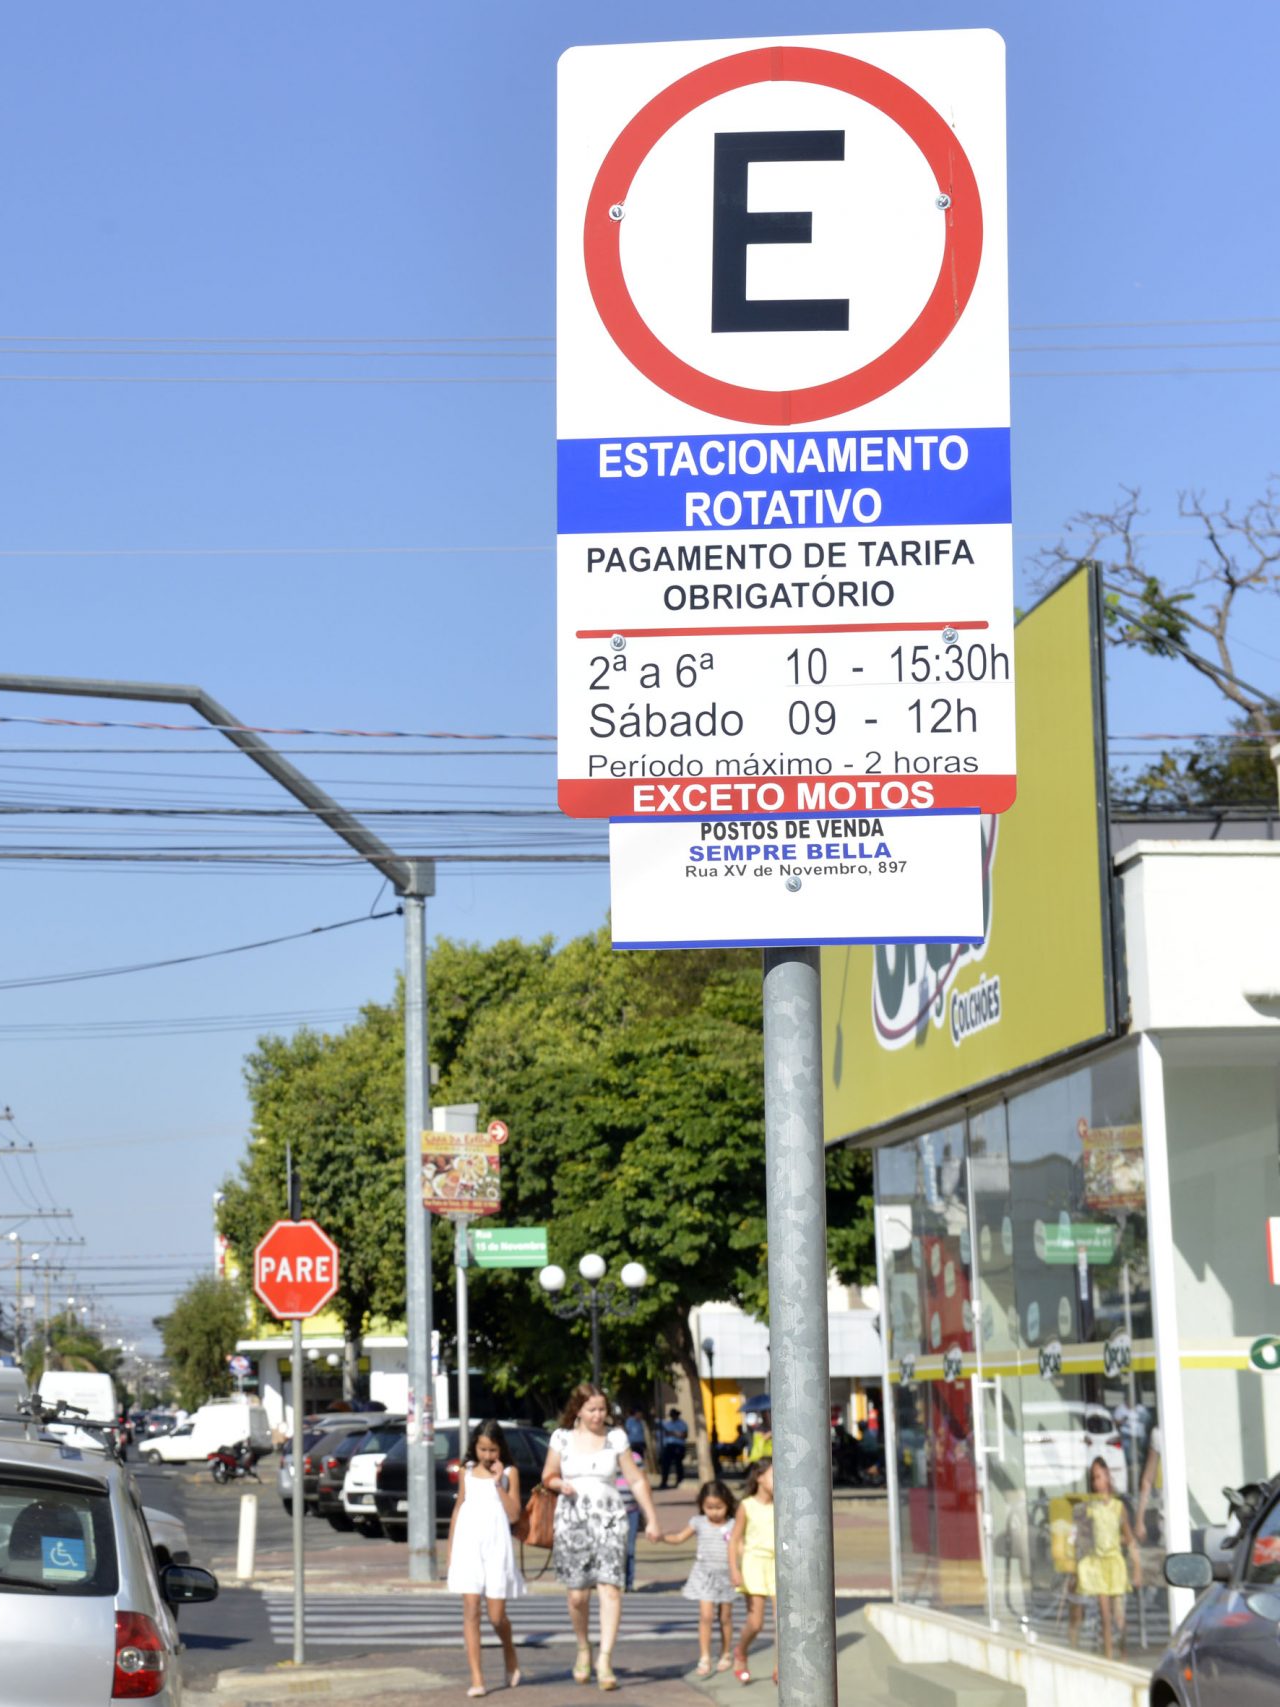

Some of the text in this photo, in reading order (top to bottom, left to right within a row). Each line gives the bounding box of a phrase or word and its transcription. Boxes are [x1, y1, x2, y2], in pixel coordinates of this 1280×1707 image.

[711, 129, 850, 333] E
[598, 434, 970, 478] ESTACIONAMENTO
[684, 487, 882, 527] ROTATIVO
[587, 539, 975, 573] PAGAMENTO DE TARIFA
[663, 575, 895, 611] OBRIGATÓRIO
[639, 663, 660, 689] a
[787, 647, 827, 685] 10
[890, 643, 1009, 682] 15:30h
[589, 702, 744, 738] Sábado
[788, 700, 836, 736] 09
[908, 698, 977, 733] 12h
[588, 754, 703, 778] Período
[715, 753, 833, 777] máximo
[865, 752, 882, 775] 2
[894, 750, 979, 774] horas
[633, 780, 935, 813] EXCETO MOTOS
[700, 818, 884, 841] POSTOS DE VENDA
[689, 842, 892, 862] SEMPRE BELLA
[685, 861, 907, 878] Rua XV de Novembro, 897
[260, 1256, 331, 1283] PARE
